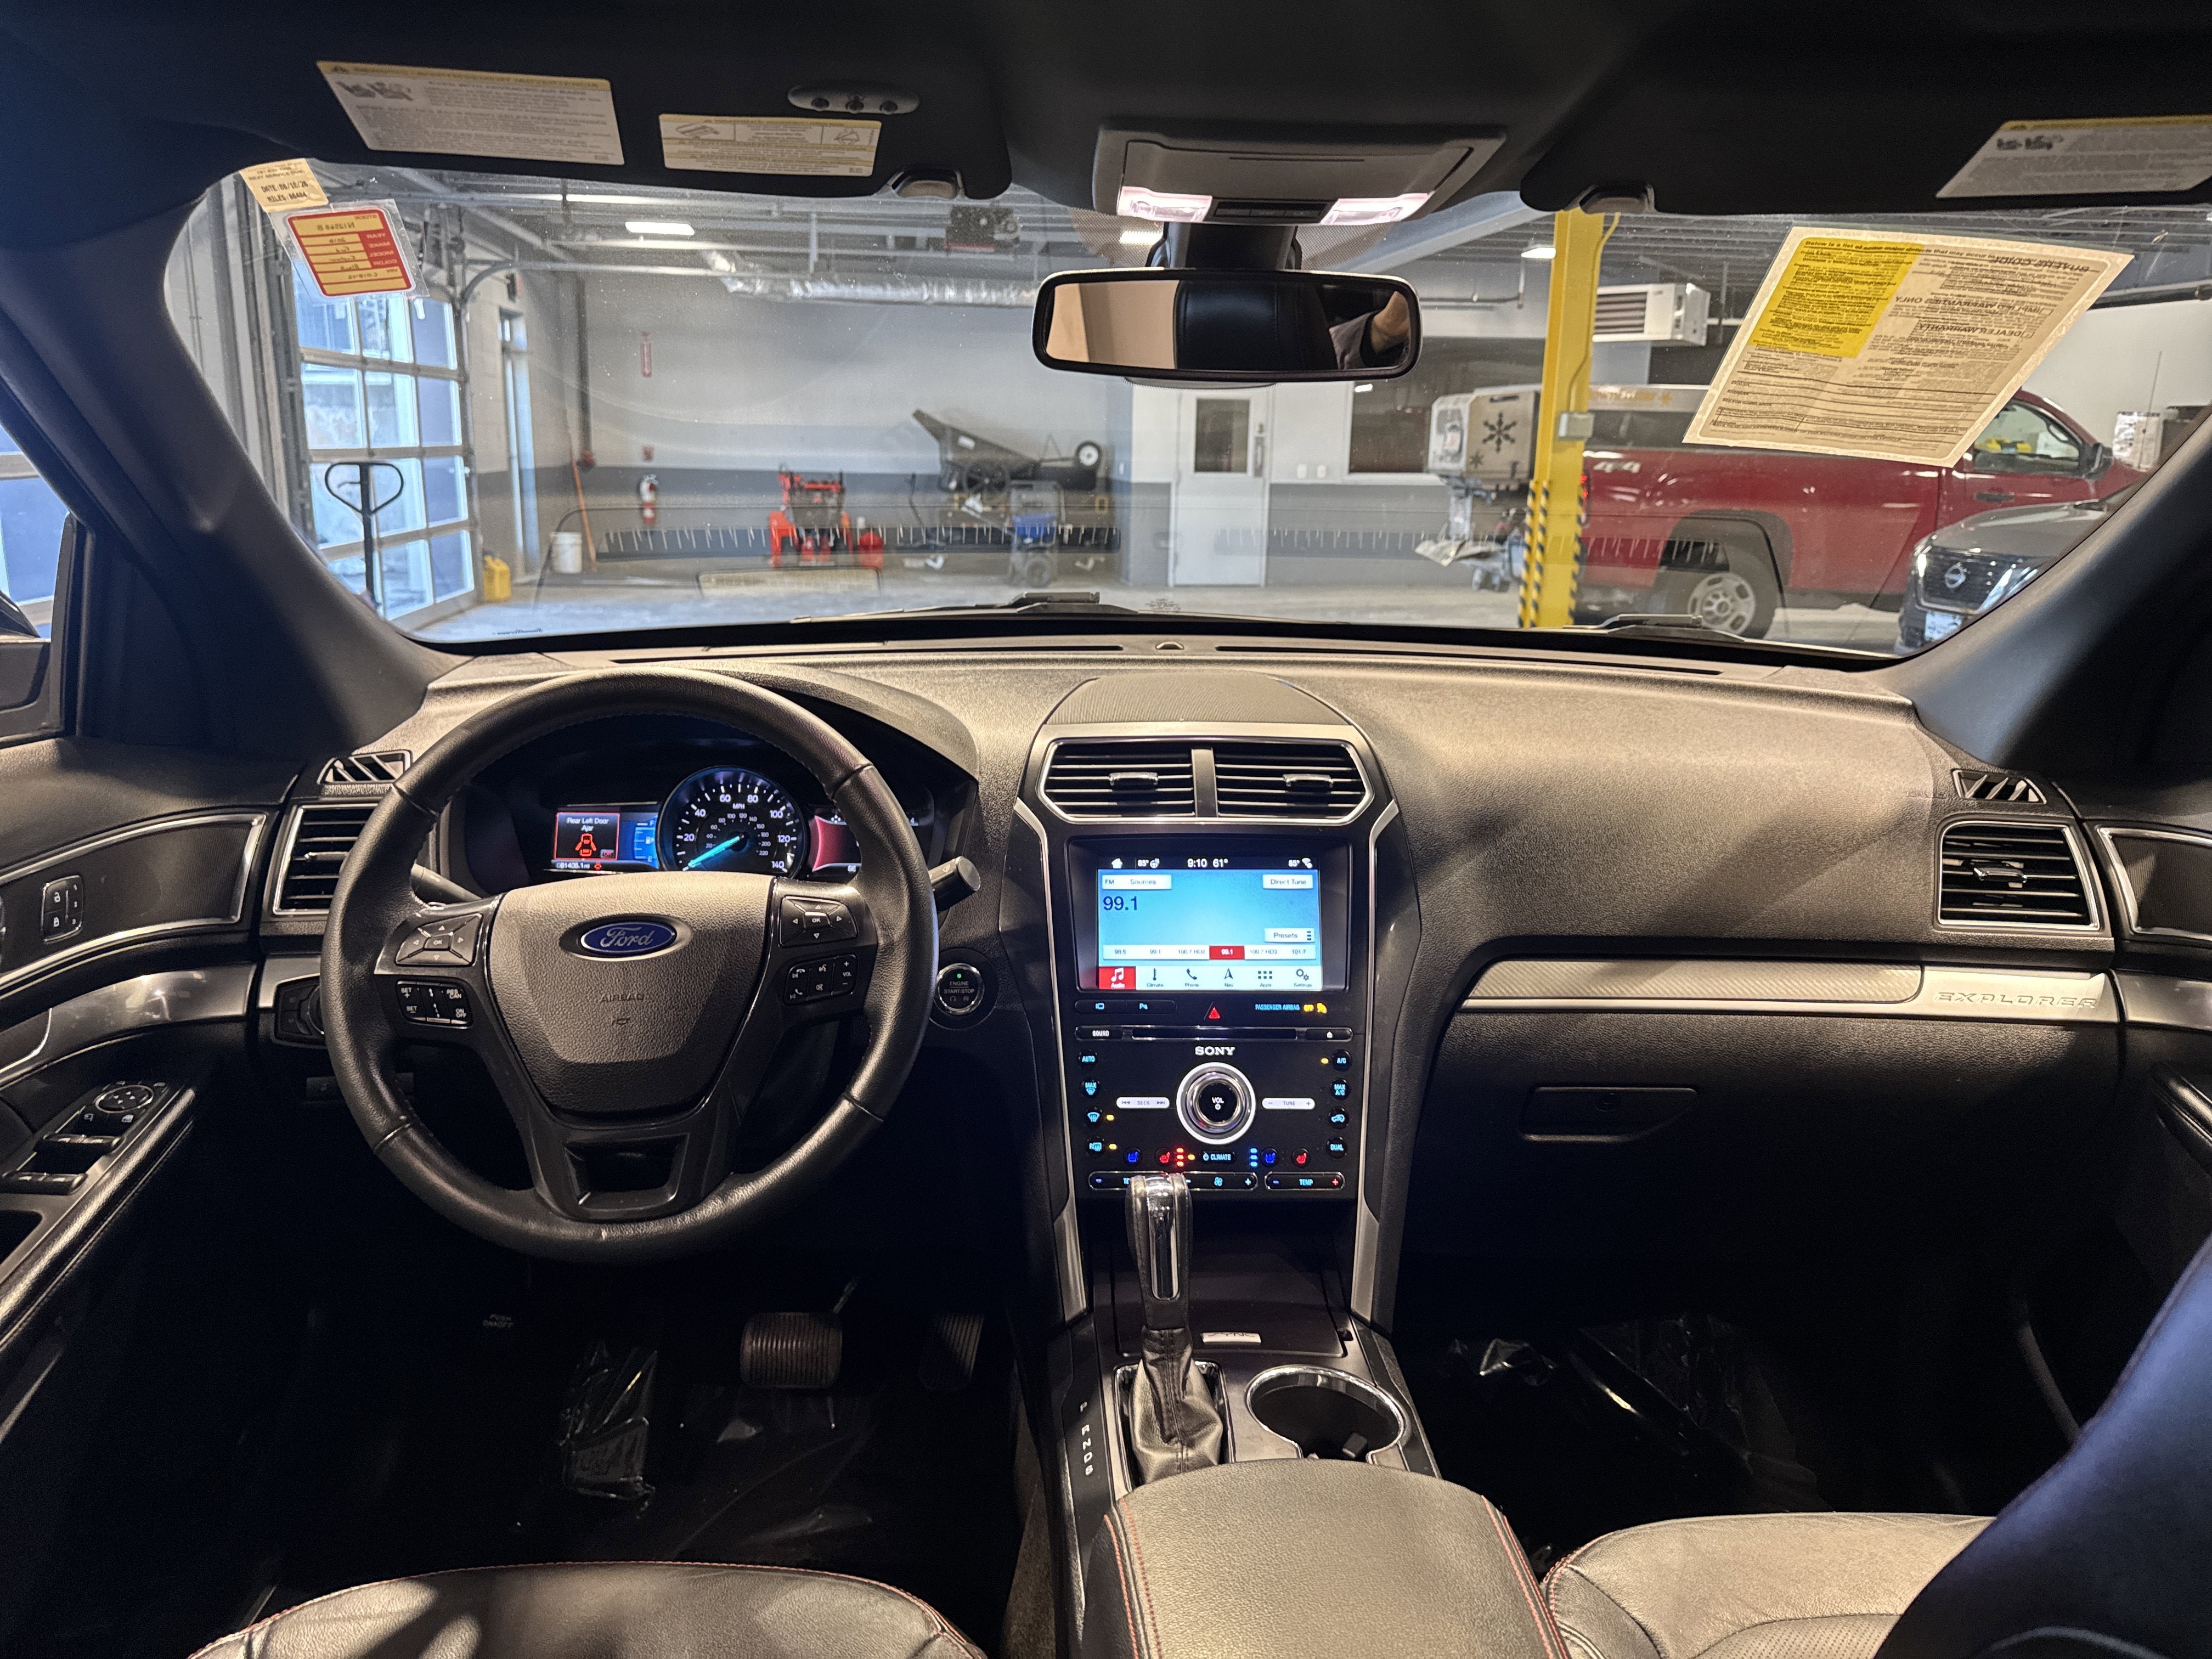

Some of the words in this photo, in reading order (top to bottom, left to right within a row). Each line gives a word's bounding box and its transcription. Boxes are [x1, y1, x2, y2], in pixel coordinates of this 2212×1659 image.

[719, 794, 731, 802] 60
[747, 794, 758, 803] 80
[695, 809, 706, 817] 40
[770, 810, 783, 818] 100
[777, 834, 790, 843] 120
[772, 860, 785, 869] 140
[1187, 858, 1207, 868] 9:10
[1103, 895, 1137, 911] 99.1
[600, 927, 656, 947] Ford
[600, 992, 645, 1003] AIRBAG
[1935, 991, 2098, 1008] EXPLORER
[1194, 1046, 1235, 1056] SONY
[1080, 1402, 1088, 1412] P
[1081, 1424, 1090, 1436] R
[1082, 1437, 1091, 1450] N
[1084, 1452, 1093, 1463] D
